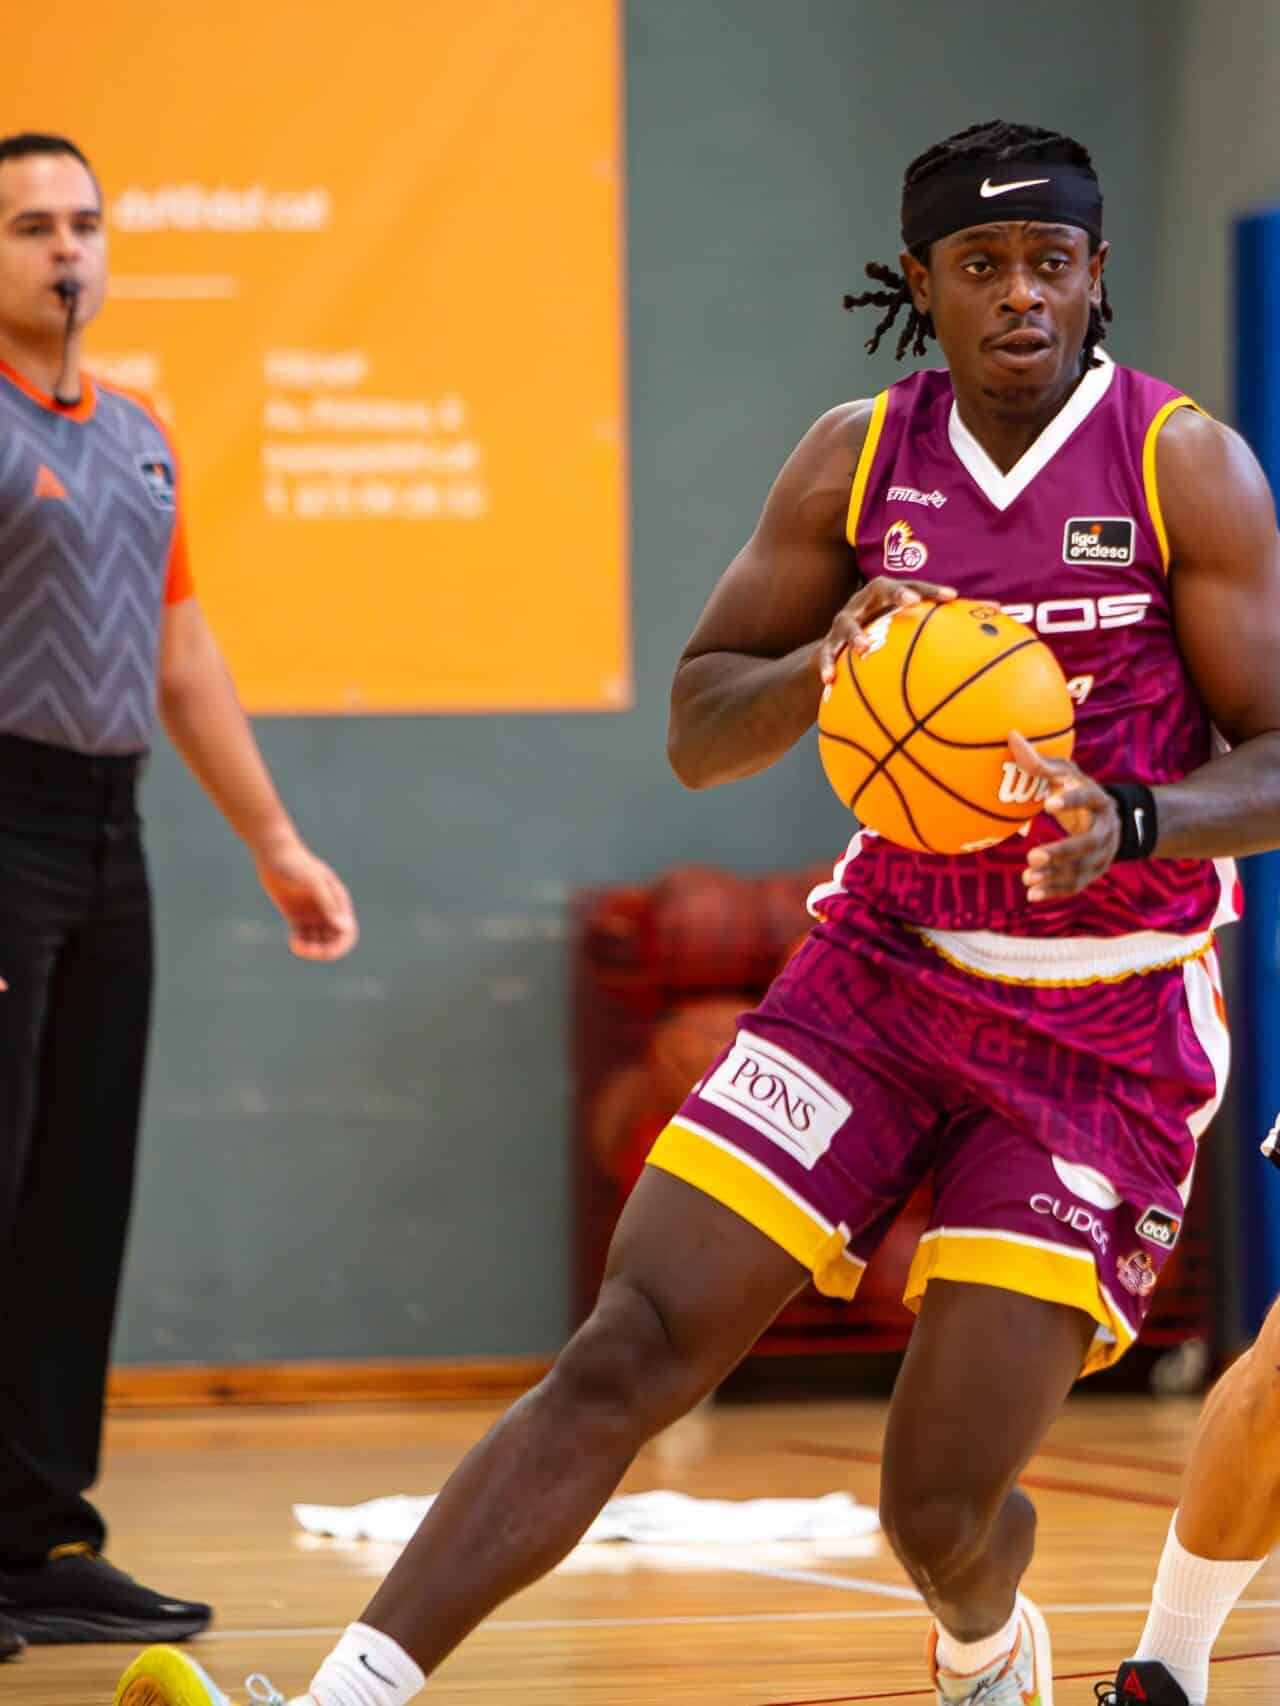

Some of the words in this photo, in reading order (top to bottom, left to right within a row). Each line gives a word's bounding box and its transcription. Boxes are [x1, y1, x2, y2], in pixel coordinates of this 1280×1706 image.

[1071, 531, 1099, 546] liga
[1070, 545, 1128, 559] endesa
[728, 1056, 816, 1132] PONS
[1142, 1220, 1169, 1242] acb
